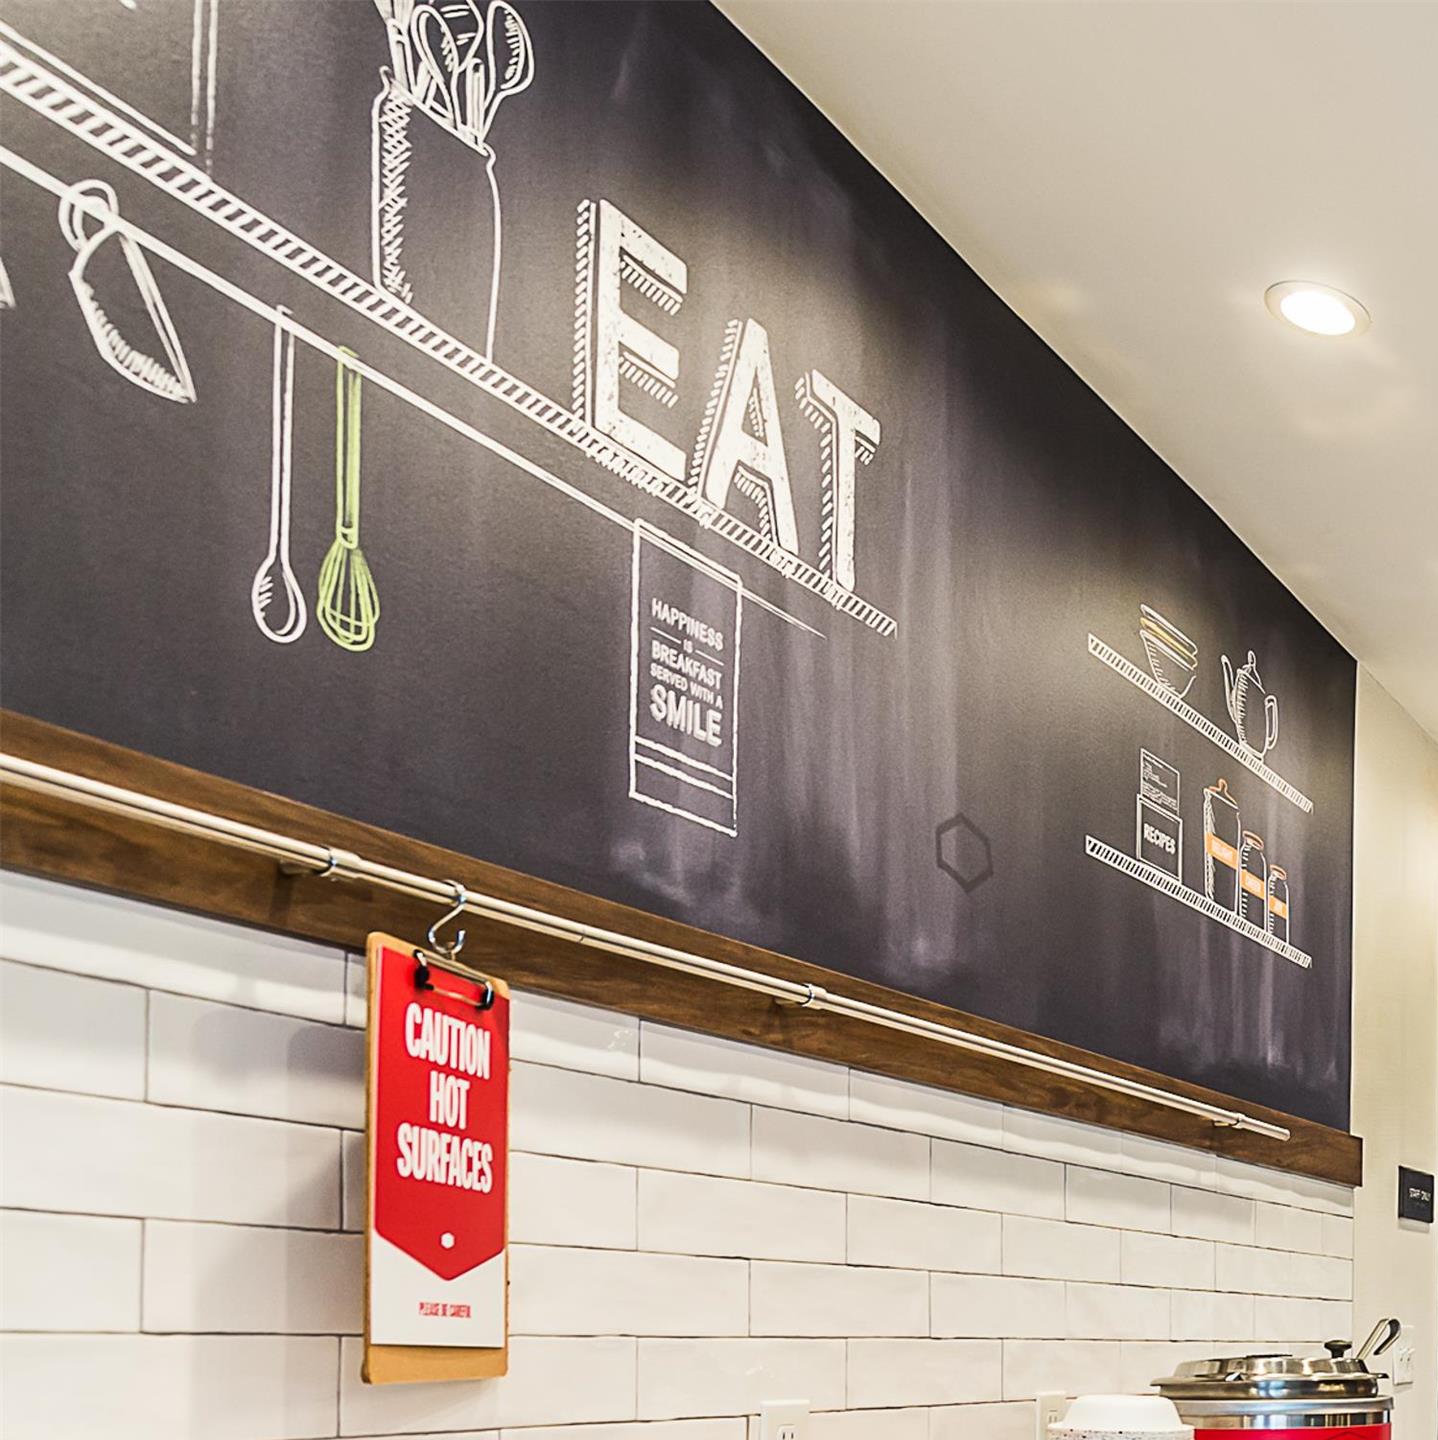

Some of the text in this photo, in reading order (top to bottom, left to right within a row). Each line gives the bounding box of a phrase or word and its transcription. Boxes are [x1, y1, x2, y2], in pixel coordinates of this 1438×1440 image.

[573, 199, 881, 592] EAT
[651, 598, 723, 651] HAPPINESS
[683, 639, 693, 653] IS
[650, 663, 723, 710] SERVED WITH A
[651, 640, 722, 689] BREAKFAST
[650, 684, 722, 747] SMILE
[1144, 823, 1176, 854] RECIPES
[405, 1003, 490, 1080] CAUTION
[429, 1070, 470, 1130] HOT
[397, 1122, 493, 1194] SURFACES
